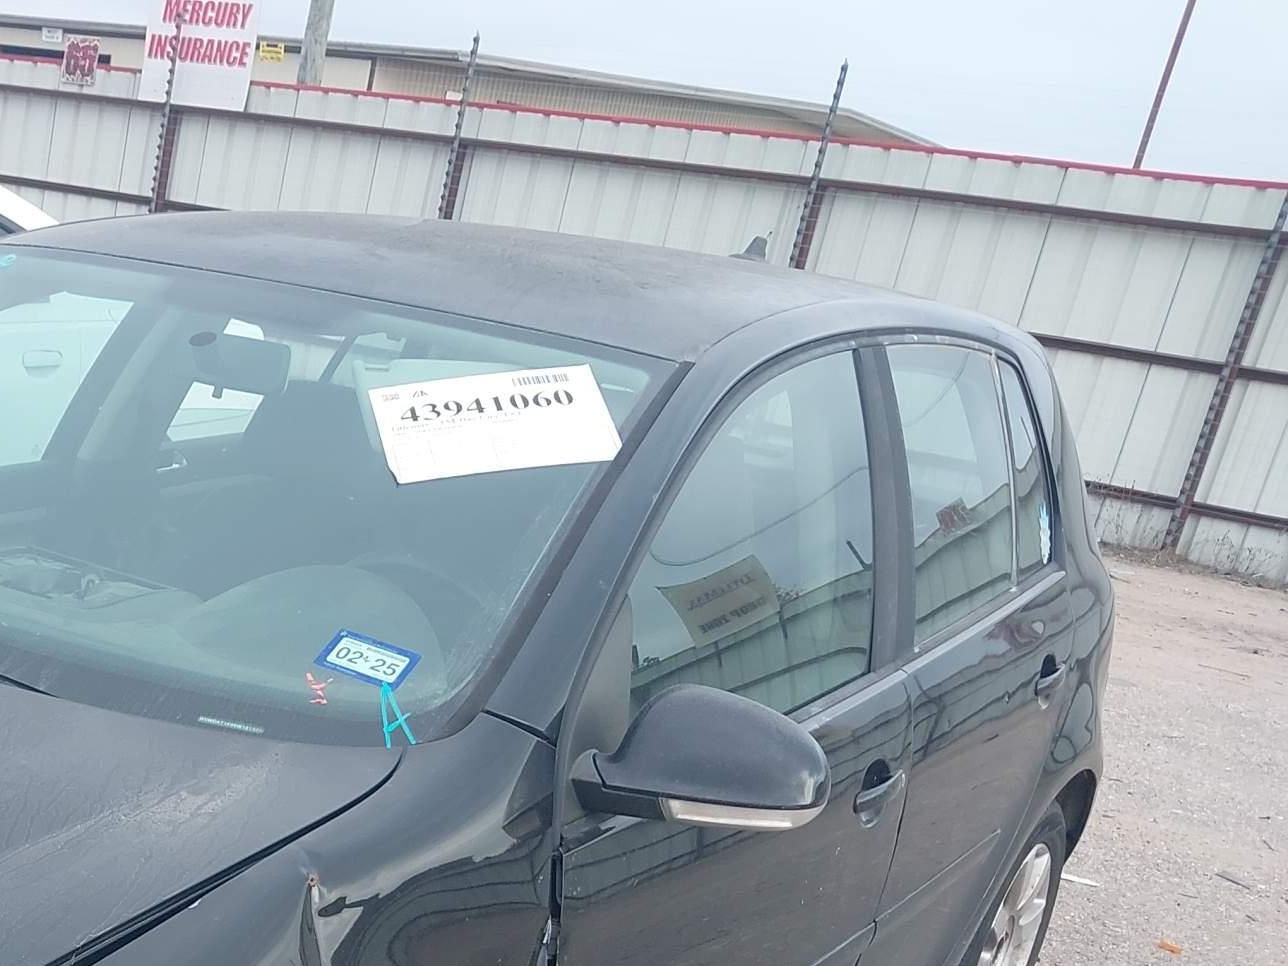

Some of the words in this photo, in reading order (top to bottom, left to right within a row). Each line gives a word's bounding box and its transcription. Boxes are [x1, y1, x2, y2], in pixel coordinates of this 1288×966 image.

[162, 0, 253, 29] MERCURY
[147, 33, 251, 67] INSURANCE
[400, 389, 574, 422] 43941060
[380, 682, 417, 749] A
